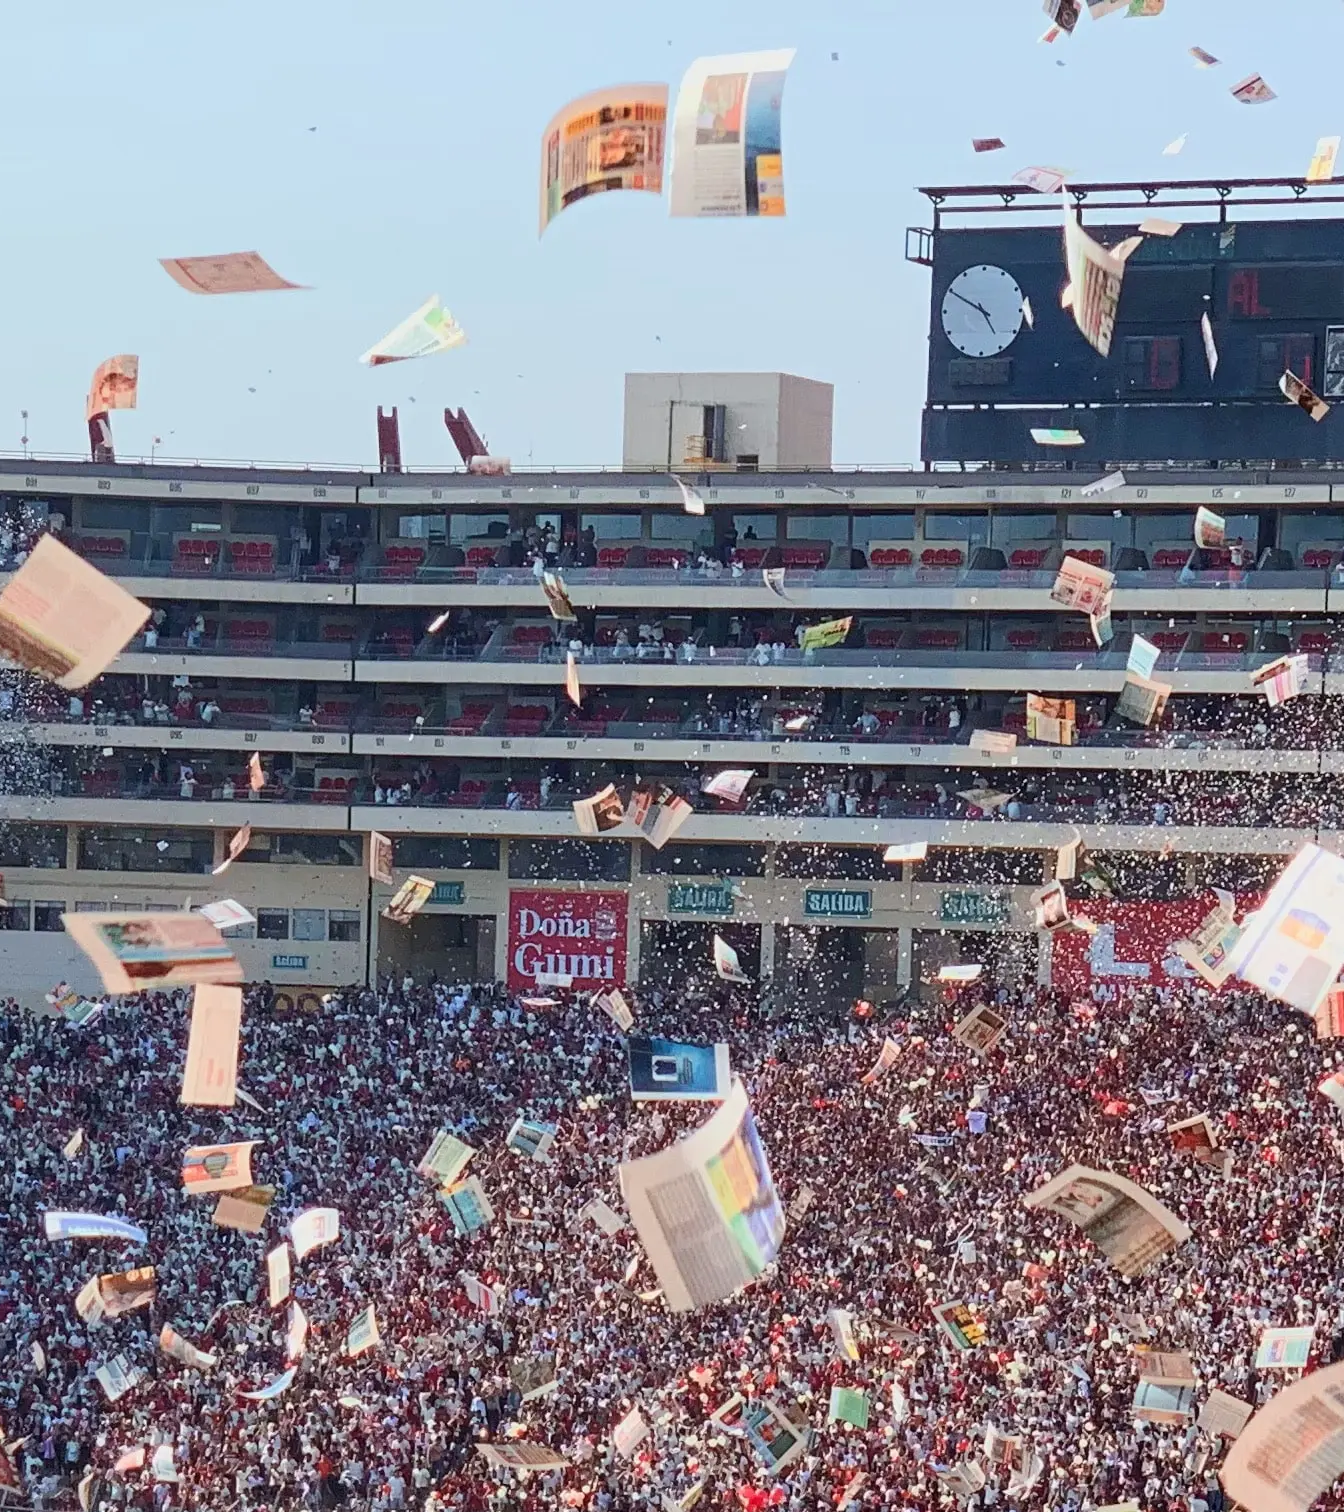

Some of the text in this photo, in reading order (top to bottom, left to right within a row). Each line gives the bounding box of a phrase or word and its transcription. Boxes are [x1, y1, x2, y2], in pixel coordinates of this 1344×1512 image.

[1284, 488, 1296, 498] 127
[808, 892, 865, 912] SALIDA
[518, 909, 591, 938] Doña
[515, 943, 614, 979] Gumi
